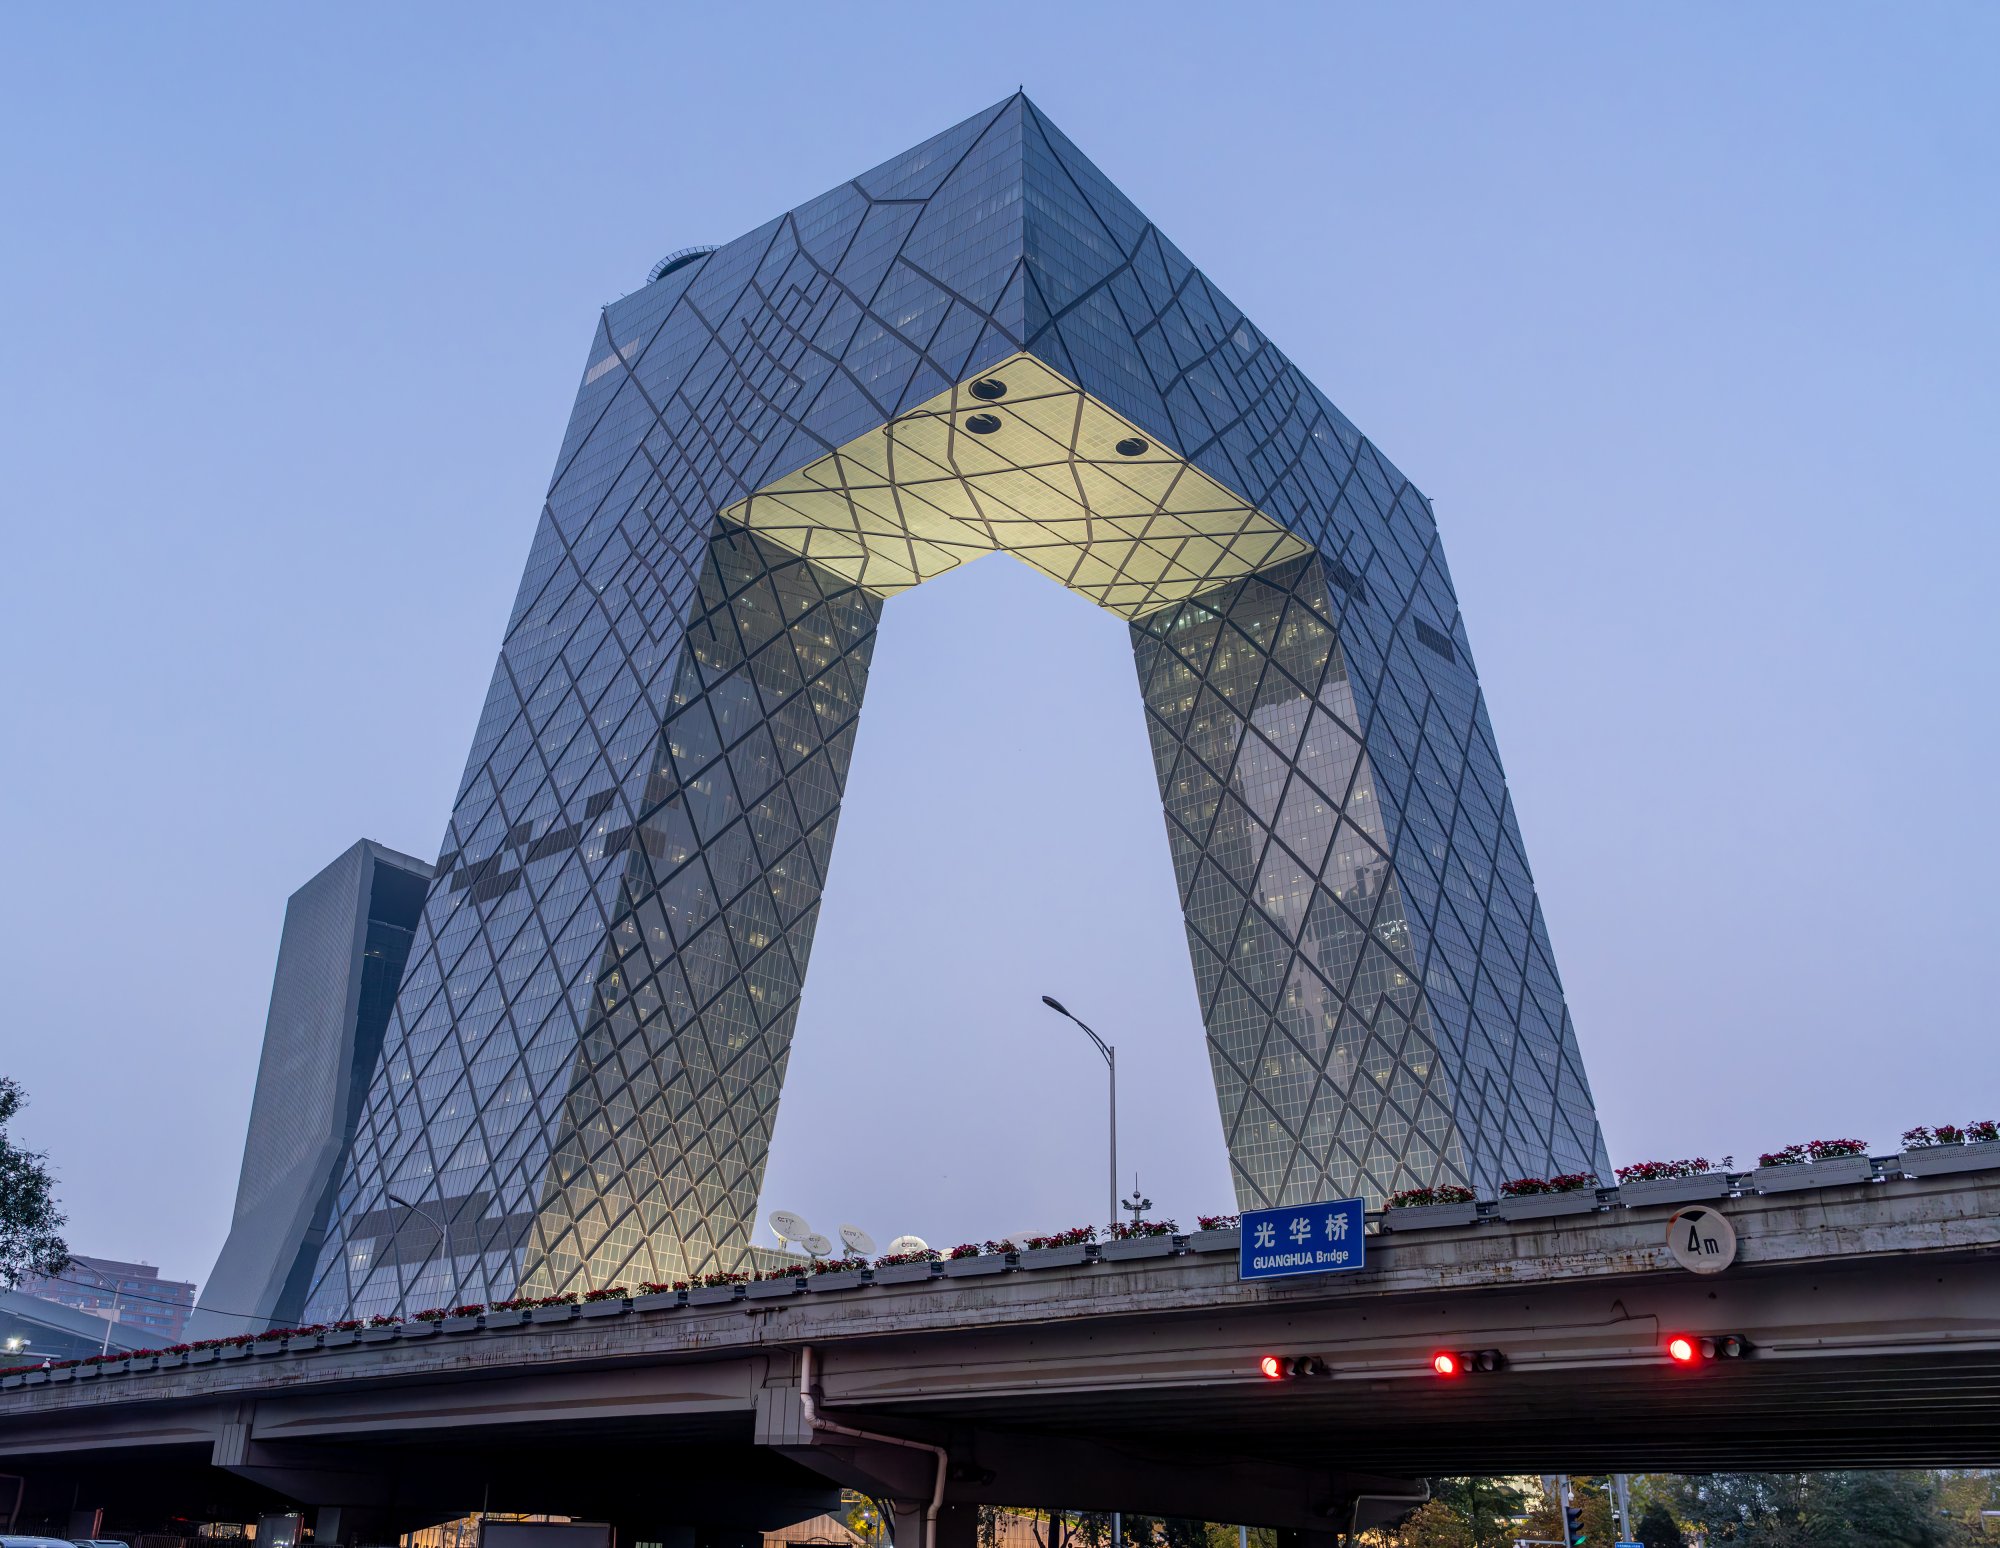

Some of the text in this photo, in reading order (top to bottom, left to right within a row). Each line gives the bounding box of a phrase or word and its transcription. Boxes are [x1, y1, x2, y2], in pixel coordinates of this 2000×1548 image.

[1254, 1212, 1349, 1249] 光华桥
[1253, 1249, 1349, 1269] GUANGHUA Bridge
